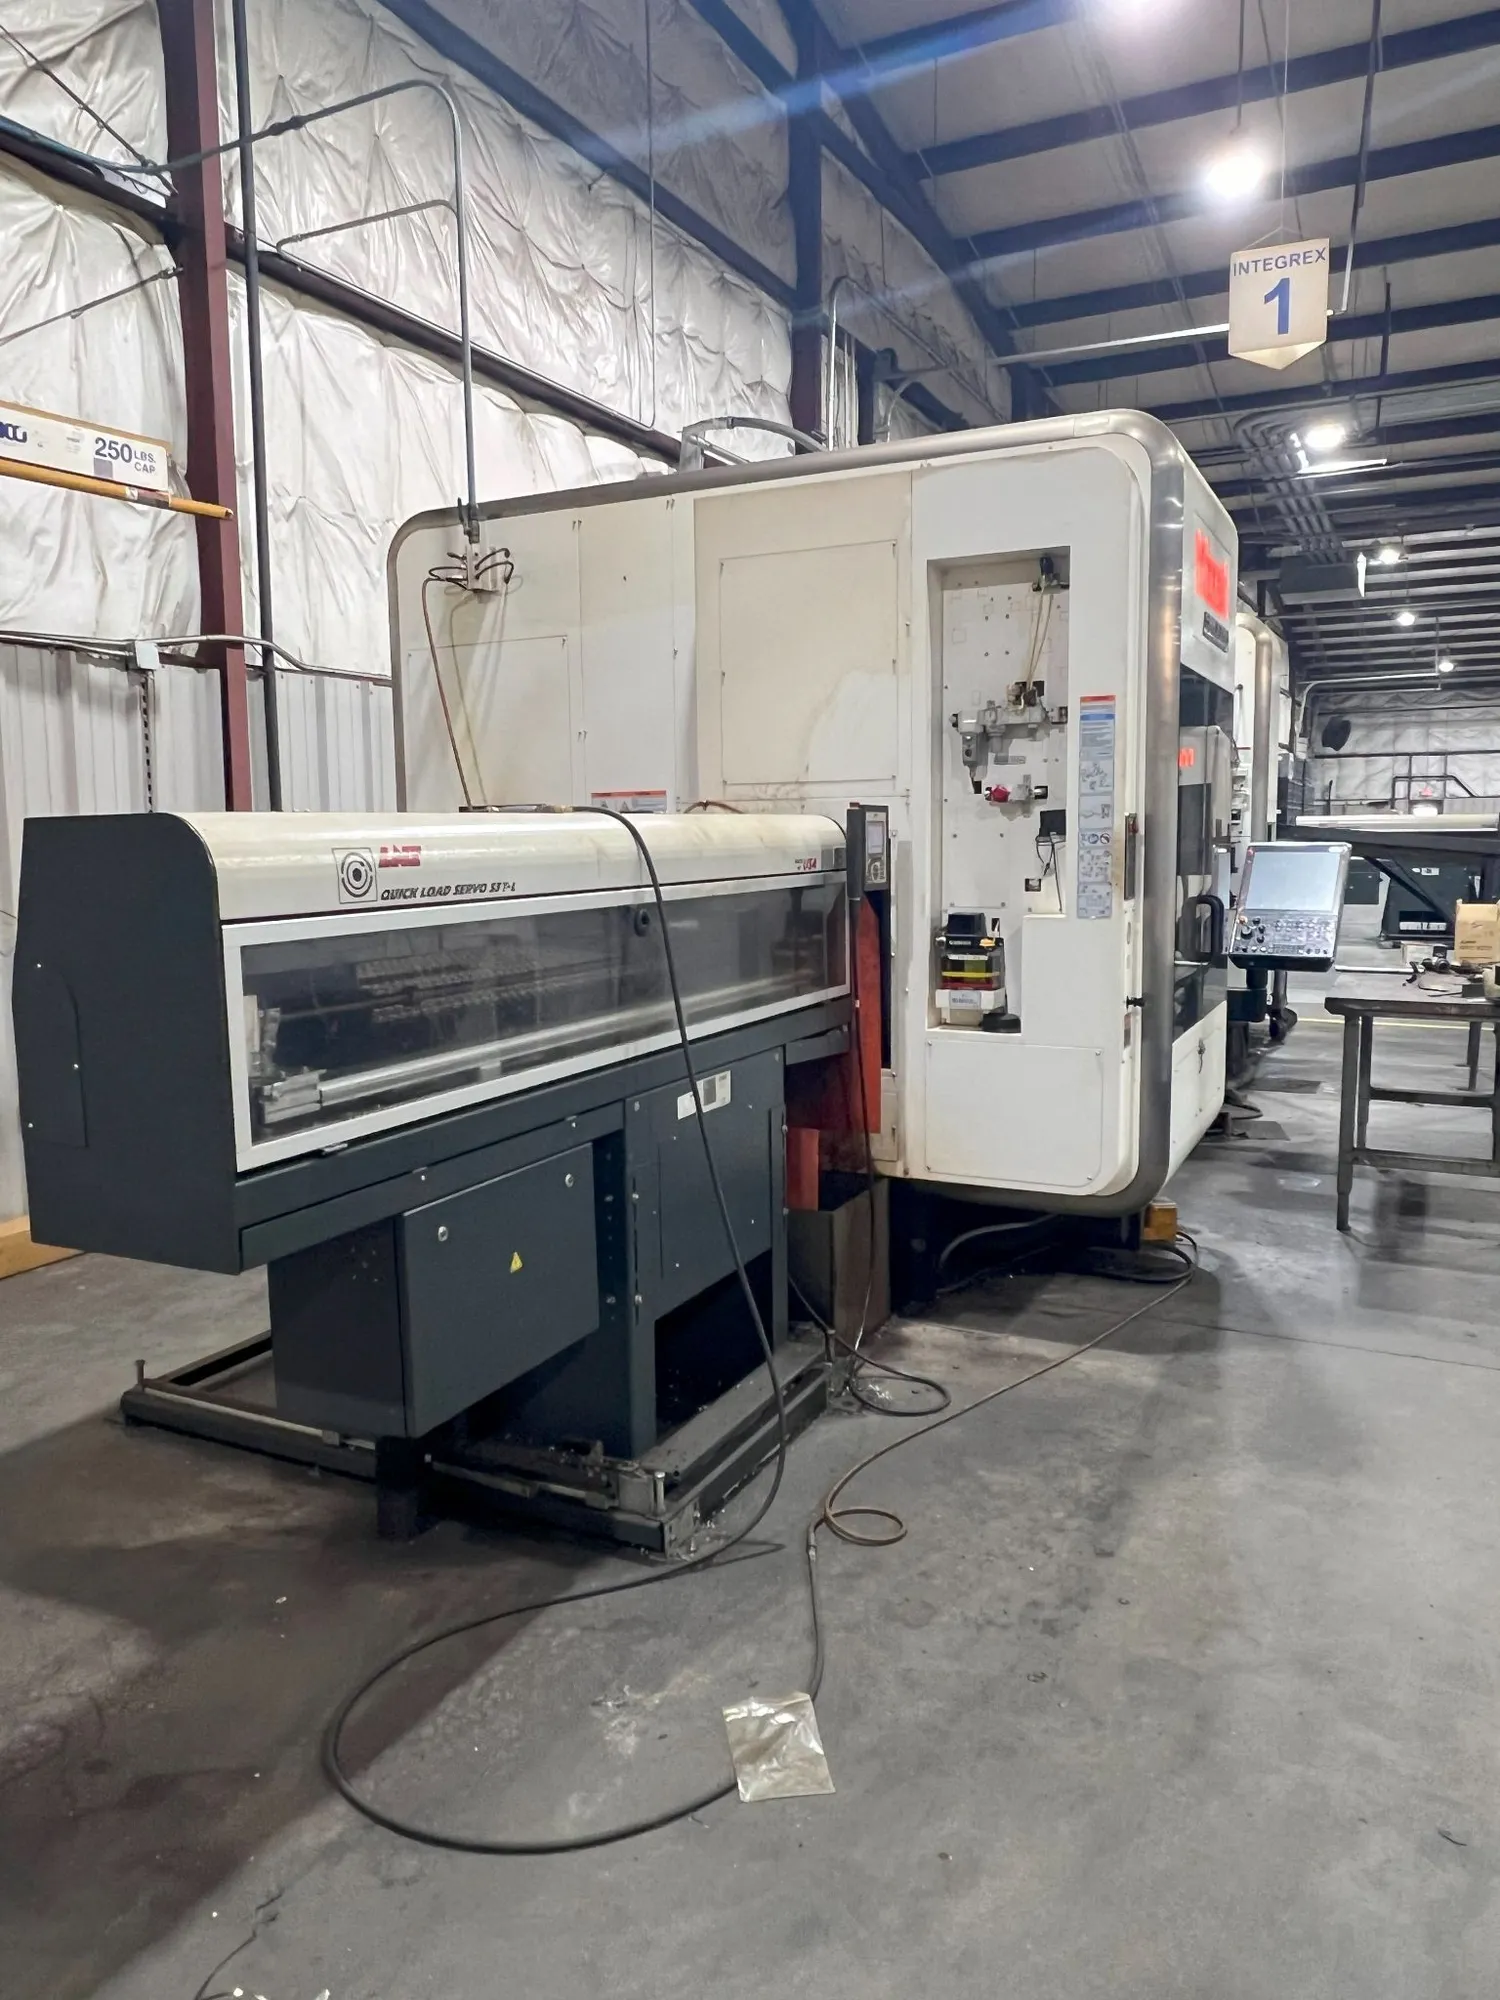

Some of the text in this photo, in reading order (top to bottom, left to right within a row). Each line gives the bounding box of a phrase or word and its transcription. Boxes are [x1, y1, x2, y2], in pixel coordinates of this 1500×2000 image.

[1233, 247, 1327, 277] INTEGREX
[1264, 277, 1290, 335] 1
[94, 437, 132, 463] 250
[134, 450, 156, 463] LBS.
[381, 887, 419, 900] QUICK
[420, 885, 452, 898] LOAD
[452, 883, 487, 896] SERVO
